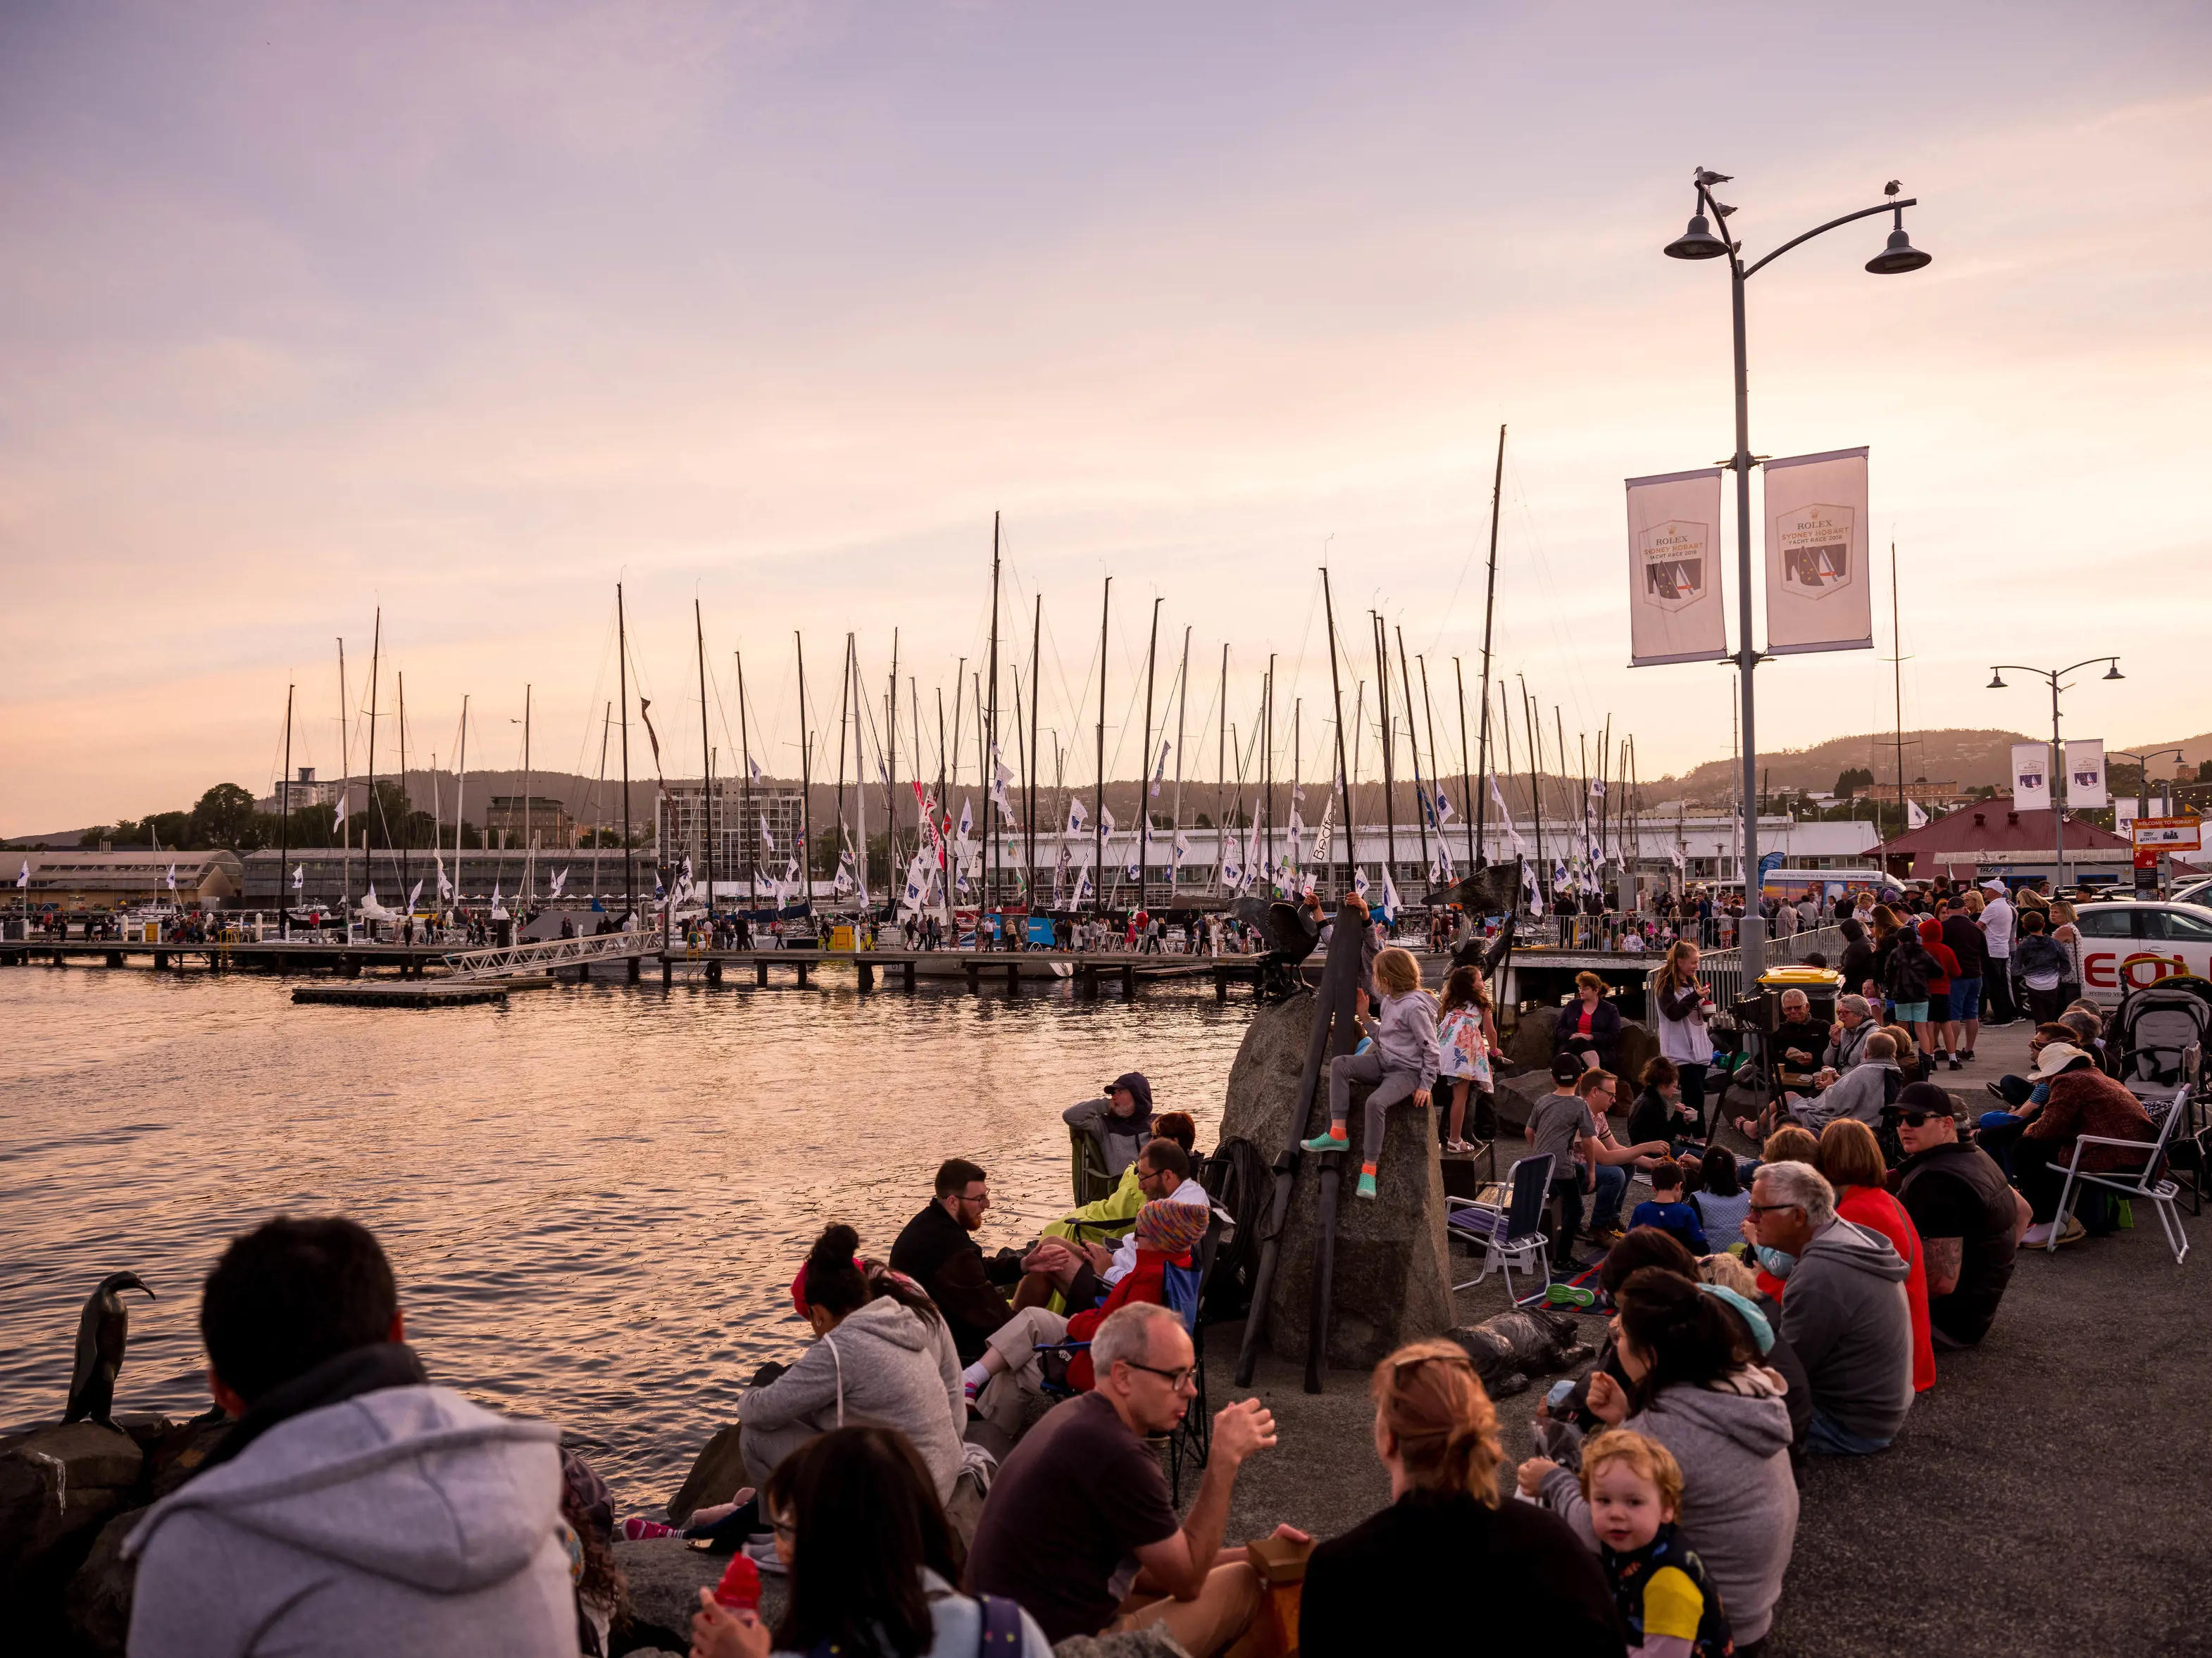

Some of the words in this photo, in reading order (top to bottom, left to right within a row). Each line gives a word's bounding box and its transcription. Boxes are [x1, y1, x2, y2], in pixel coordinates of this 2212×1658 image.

[1797, 520, 1833, 530] ROLEX
[1782, 531, 1813, 541] SYDNEY
[1816, 527, 1849, 536] HOBART
[1656, 535, 1688, 546] ROLEX
[1643, 546, 1670, 555] SYDNEY
[1672, 542, 1704, 551] HOBART
